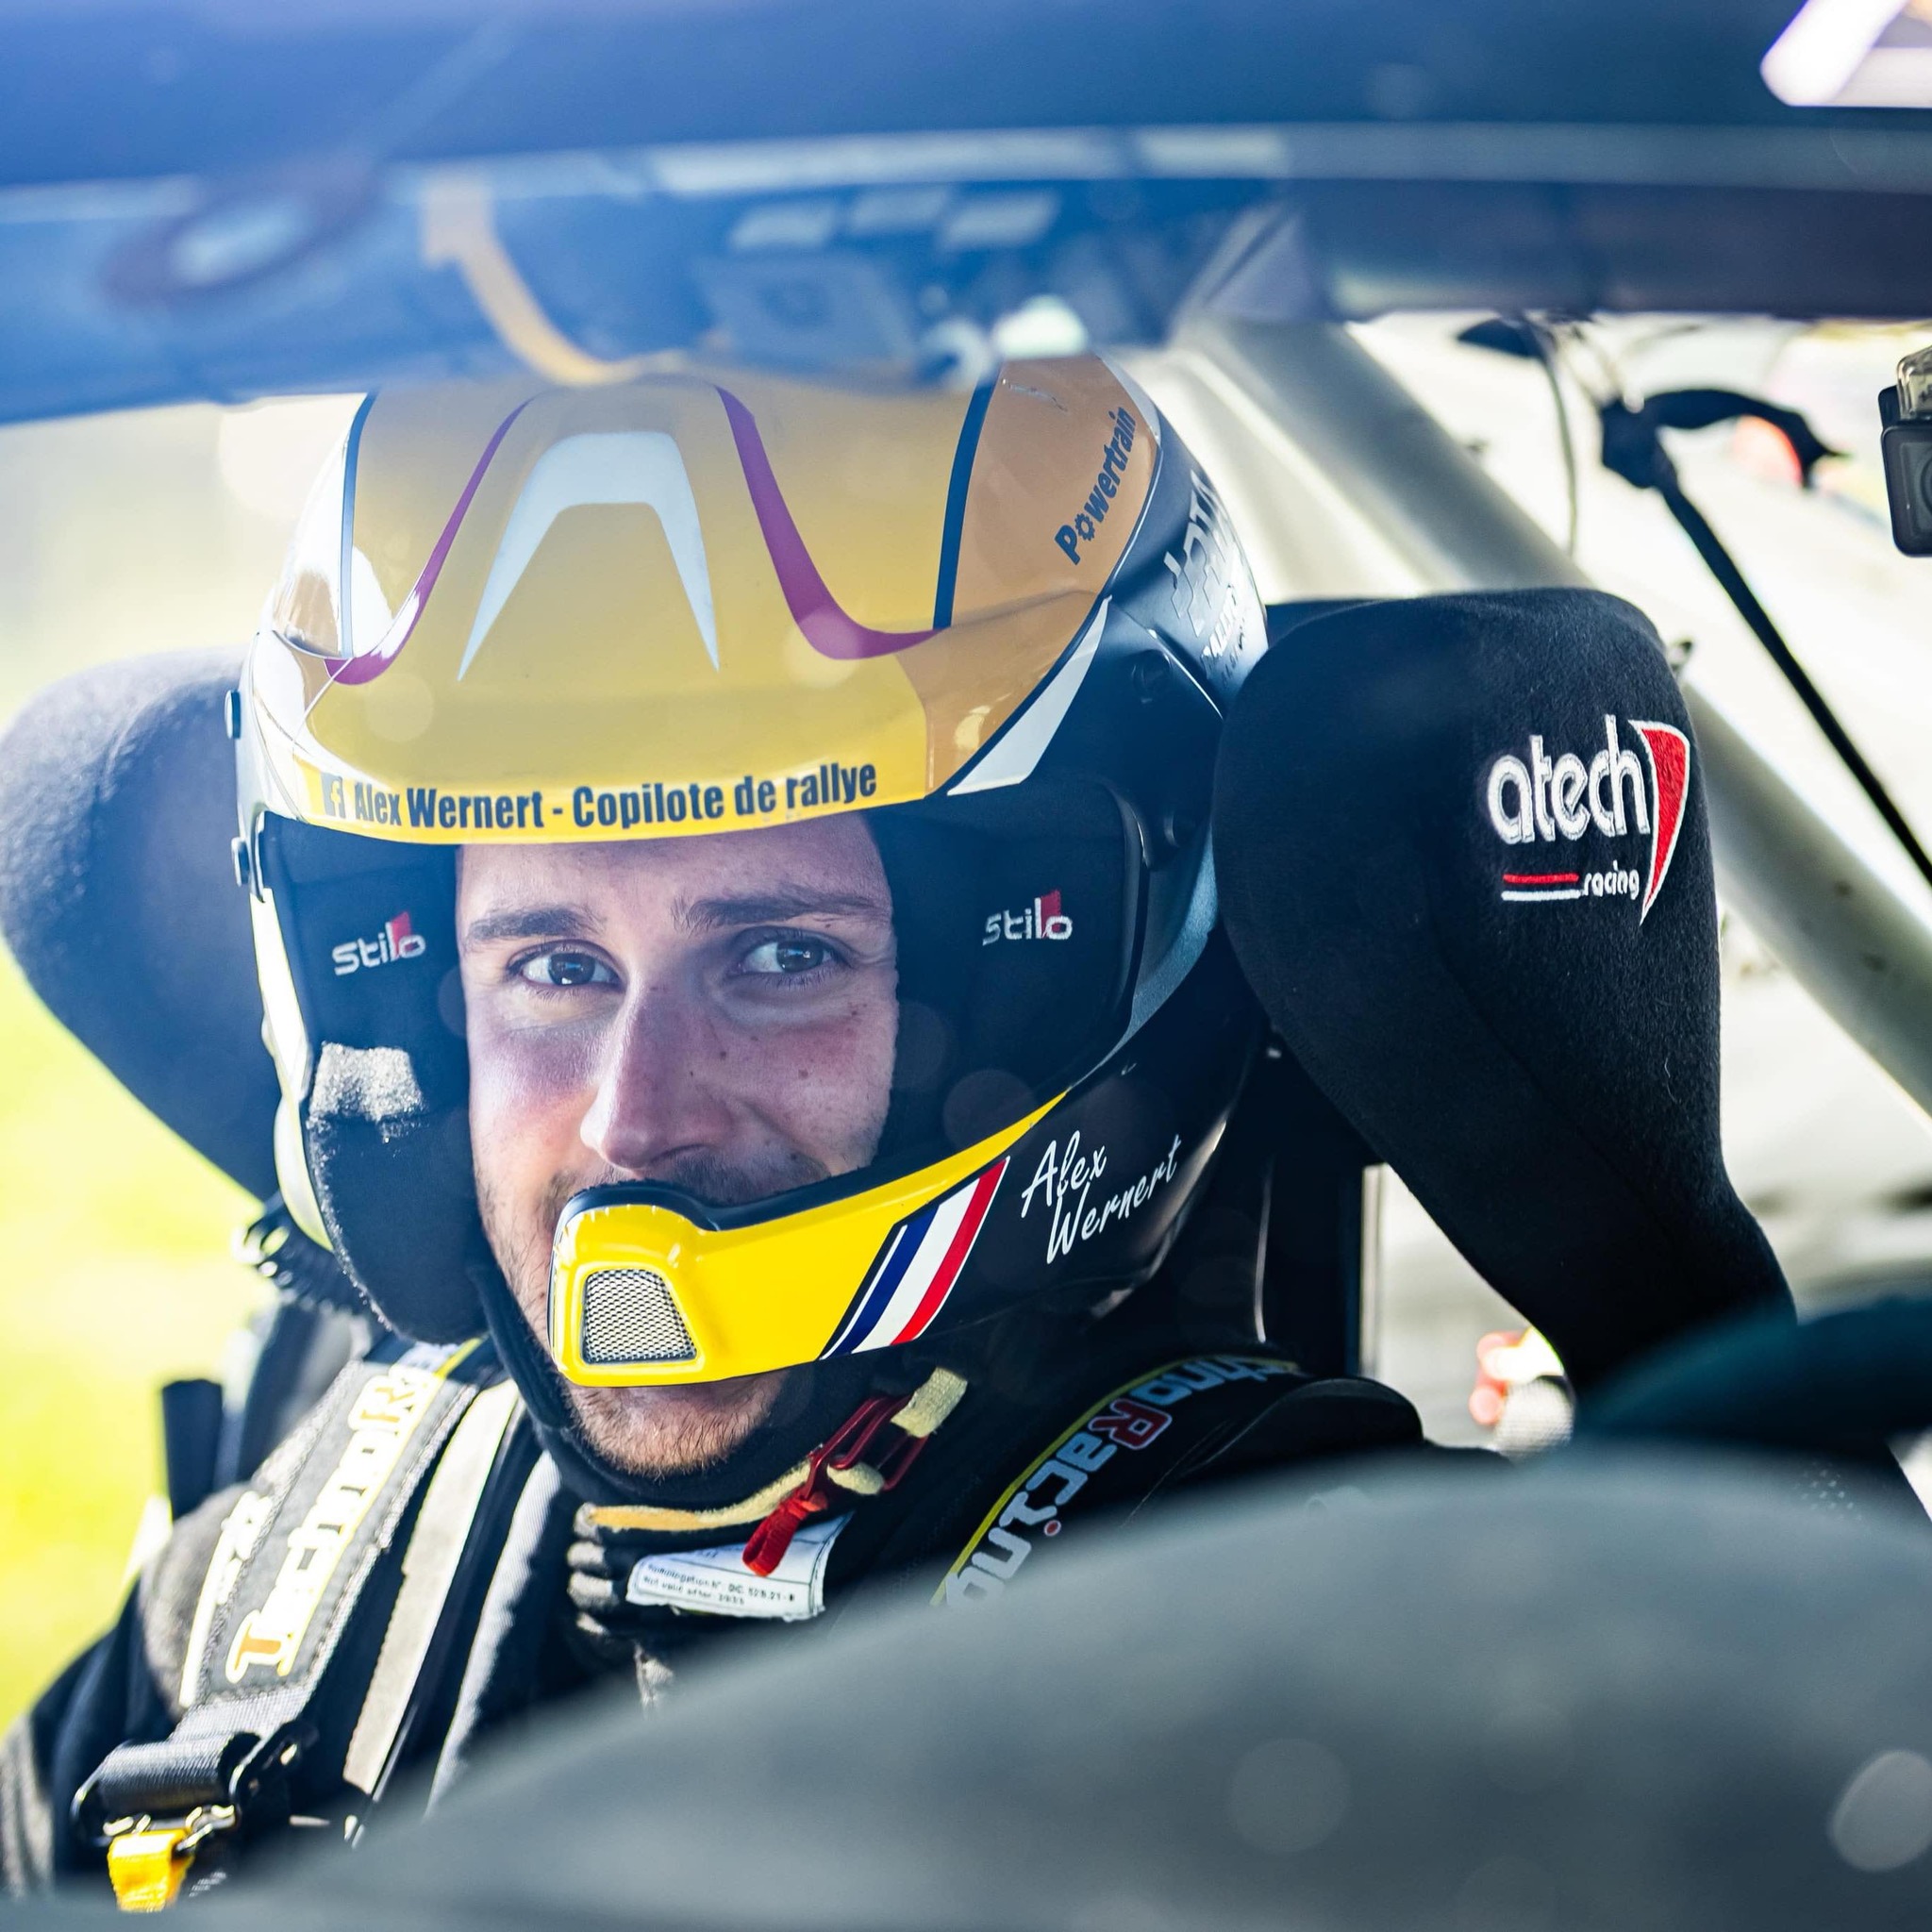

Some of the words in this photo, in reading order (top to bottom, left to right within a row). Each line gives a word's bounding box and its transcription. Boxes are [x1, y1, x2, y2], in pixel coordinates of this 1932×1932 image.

[1054, 406, 1137, 566] Powertrain
[354, 780, 403, 827] Alex
[406, 785, 545, 830] Wernert
[572, 775, 731, 830] Copilote
[734, 774, 777, 816] de
[785, 761, 877, 811] rallye
[1487, 713, 1651, 845] atech
[982, 889, 1074, 947] stilo
[1581, 859, 1641, 901] racing
[331, 910, 427, 976] stilo
[1020, 1129, 1108, 1219] Alex
[1045, 1133, 1182, 1265] Wernert
